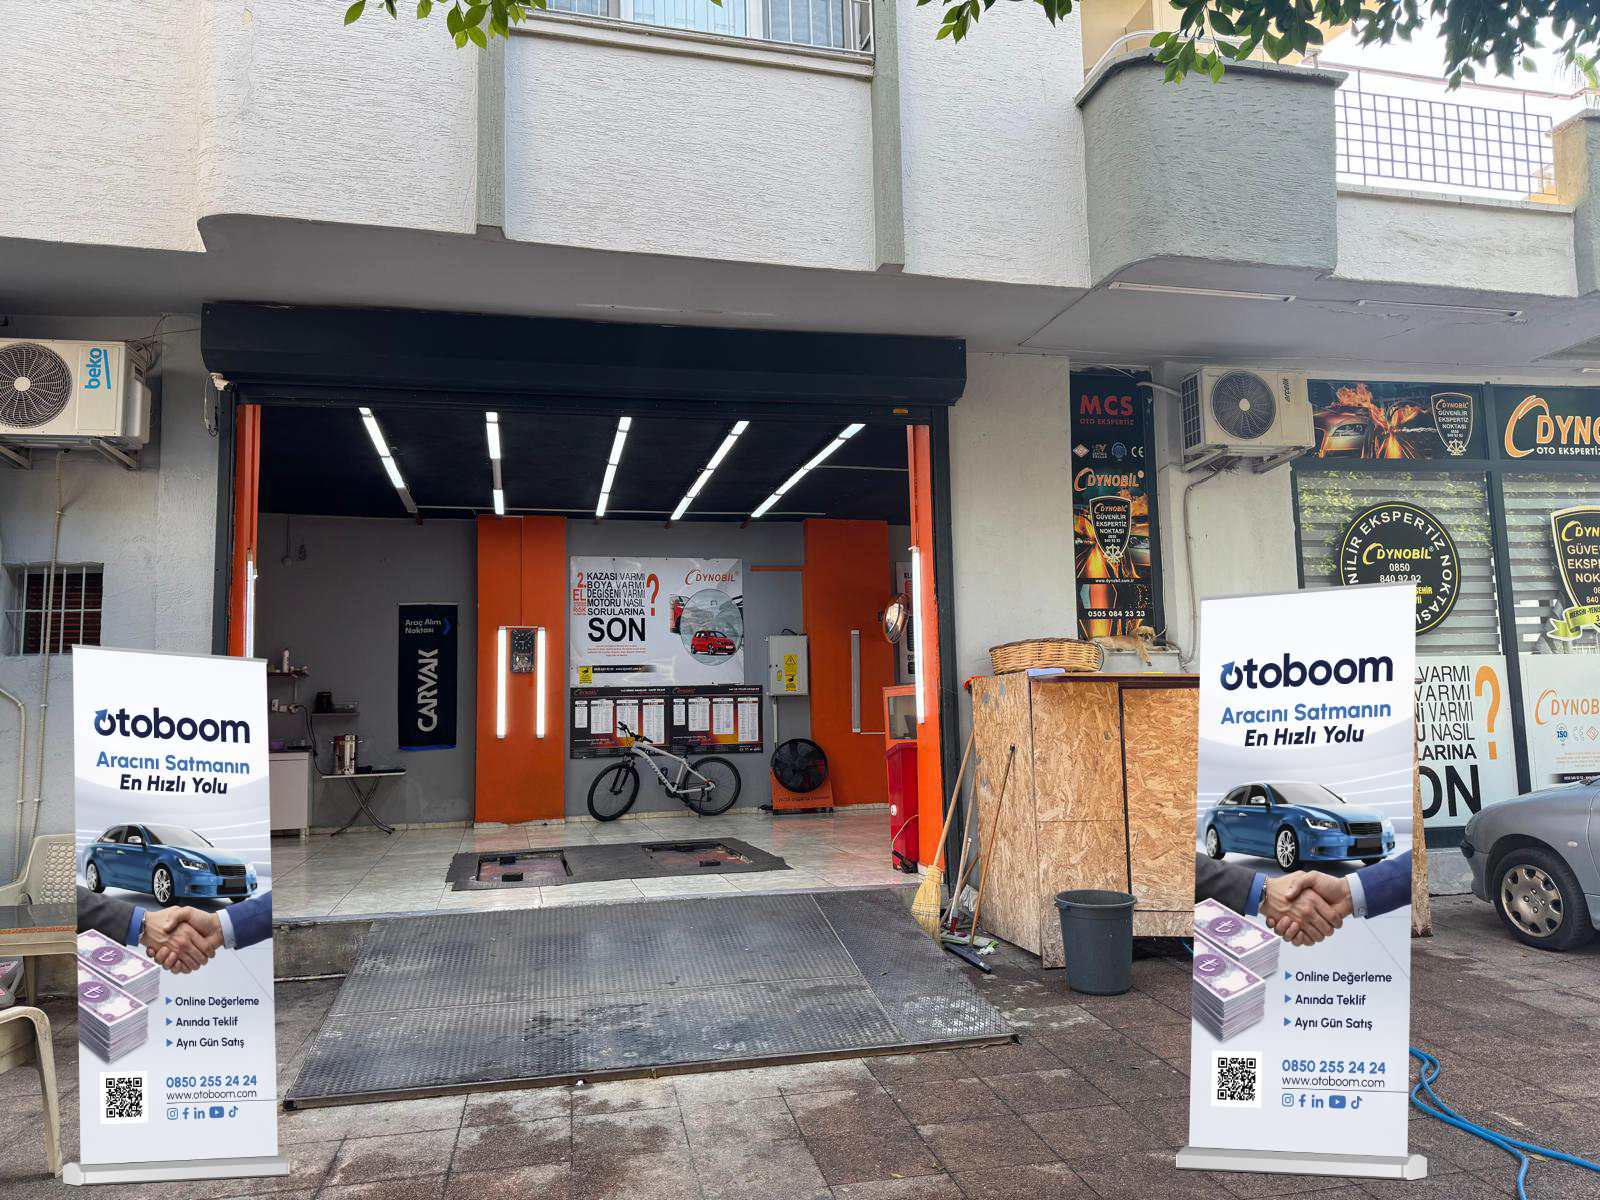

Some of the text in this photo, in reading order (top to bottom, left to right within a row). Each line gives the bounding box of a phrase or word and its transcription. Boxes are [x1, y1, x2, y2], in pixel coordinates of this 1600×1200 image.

[85, 348, 103, 389] beko
[1080, 395, 1134, 416] MCS
[1537, 447, 1556, 455] OTO
[1359, 511, 1446, 550] EKSPERTİZ
[1567, 544, 1600, 555] GÜVE
[1389, 563, 1410, 571] 0850
[587, 581, 645, 589] BOYA VARMI
[587, 599, 621, 607] MOTORU
[587, 608, 645, 616] SORULARINA
[588, 617, 645, 642] SON
[1220, 653, 1393, 691] otoboom
[1418, 665, 1470, 682] VARMI
[417, 648, 439, 732] CARVAK
[1415, 685, 1471, 701] VARMI
[1220, 703, 1392, 725] Aracını Satmanın
[1428, 702, 1474, 722] VARMI
[94, 707, 250, 743] otoboom
[1431, 723, 1475, 741] NASIL
[1244, 724, 1364, 747] En Hızlı Yolu
[1418, 744, 1477, 760] ARINA
[96, 751, 250, 774] Aracını Satmanın
[120, 774, 228, 794] En Hızlı Yolu
[1295, 971, 1392, 985] Online Değerleme
[175, 996, 259, 1008] Online Değerleme
[1295, 994, 1366, 1006] Anında Teklif
[176, 1017, 239, 1027] Anında Teklif
[1294, 1017, 1373, 1031] Aynı Gün Satış
[176, 1038, 245, 1050] Aynı Gün Satış
[1281, 1059, 1386, 1075] 0850 255 24 24
[166, 1075, 257, 1088] 0850 255 24 24
[1281, 1075, 1386, 1088] www.otoboom.com
[166, 1089, 257, 1100] www.otoboom.com
